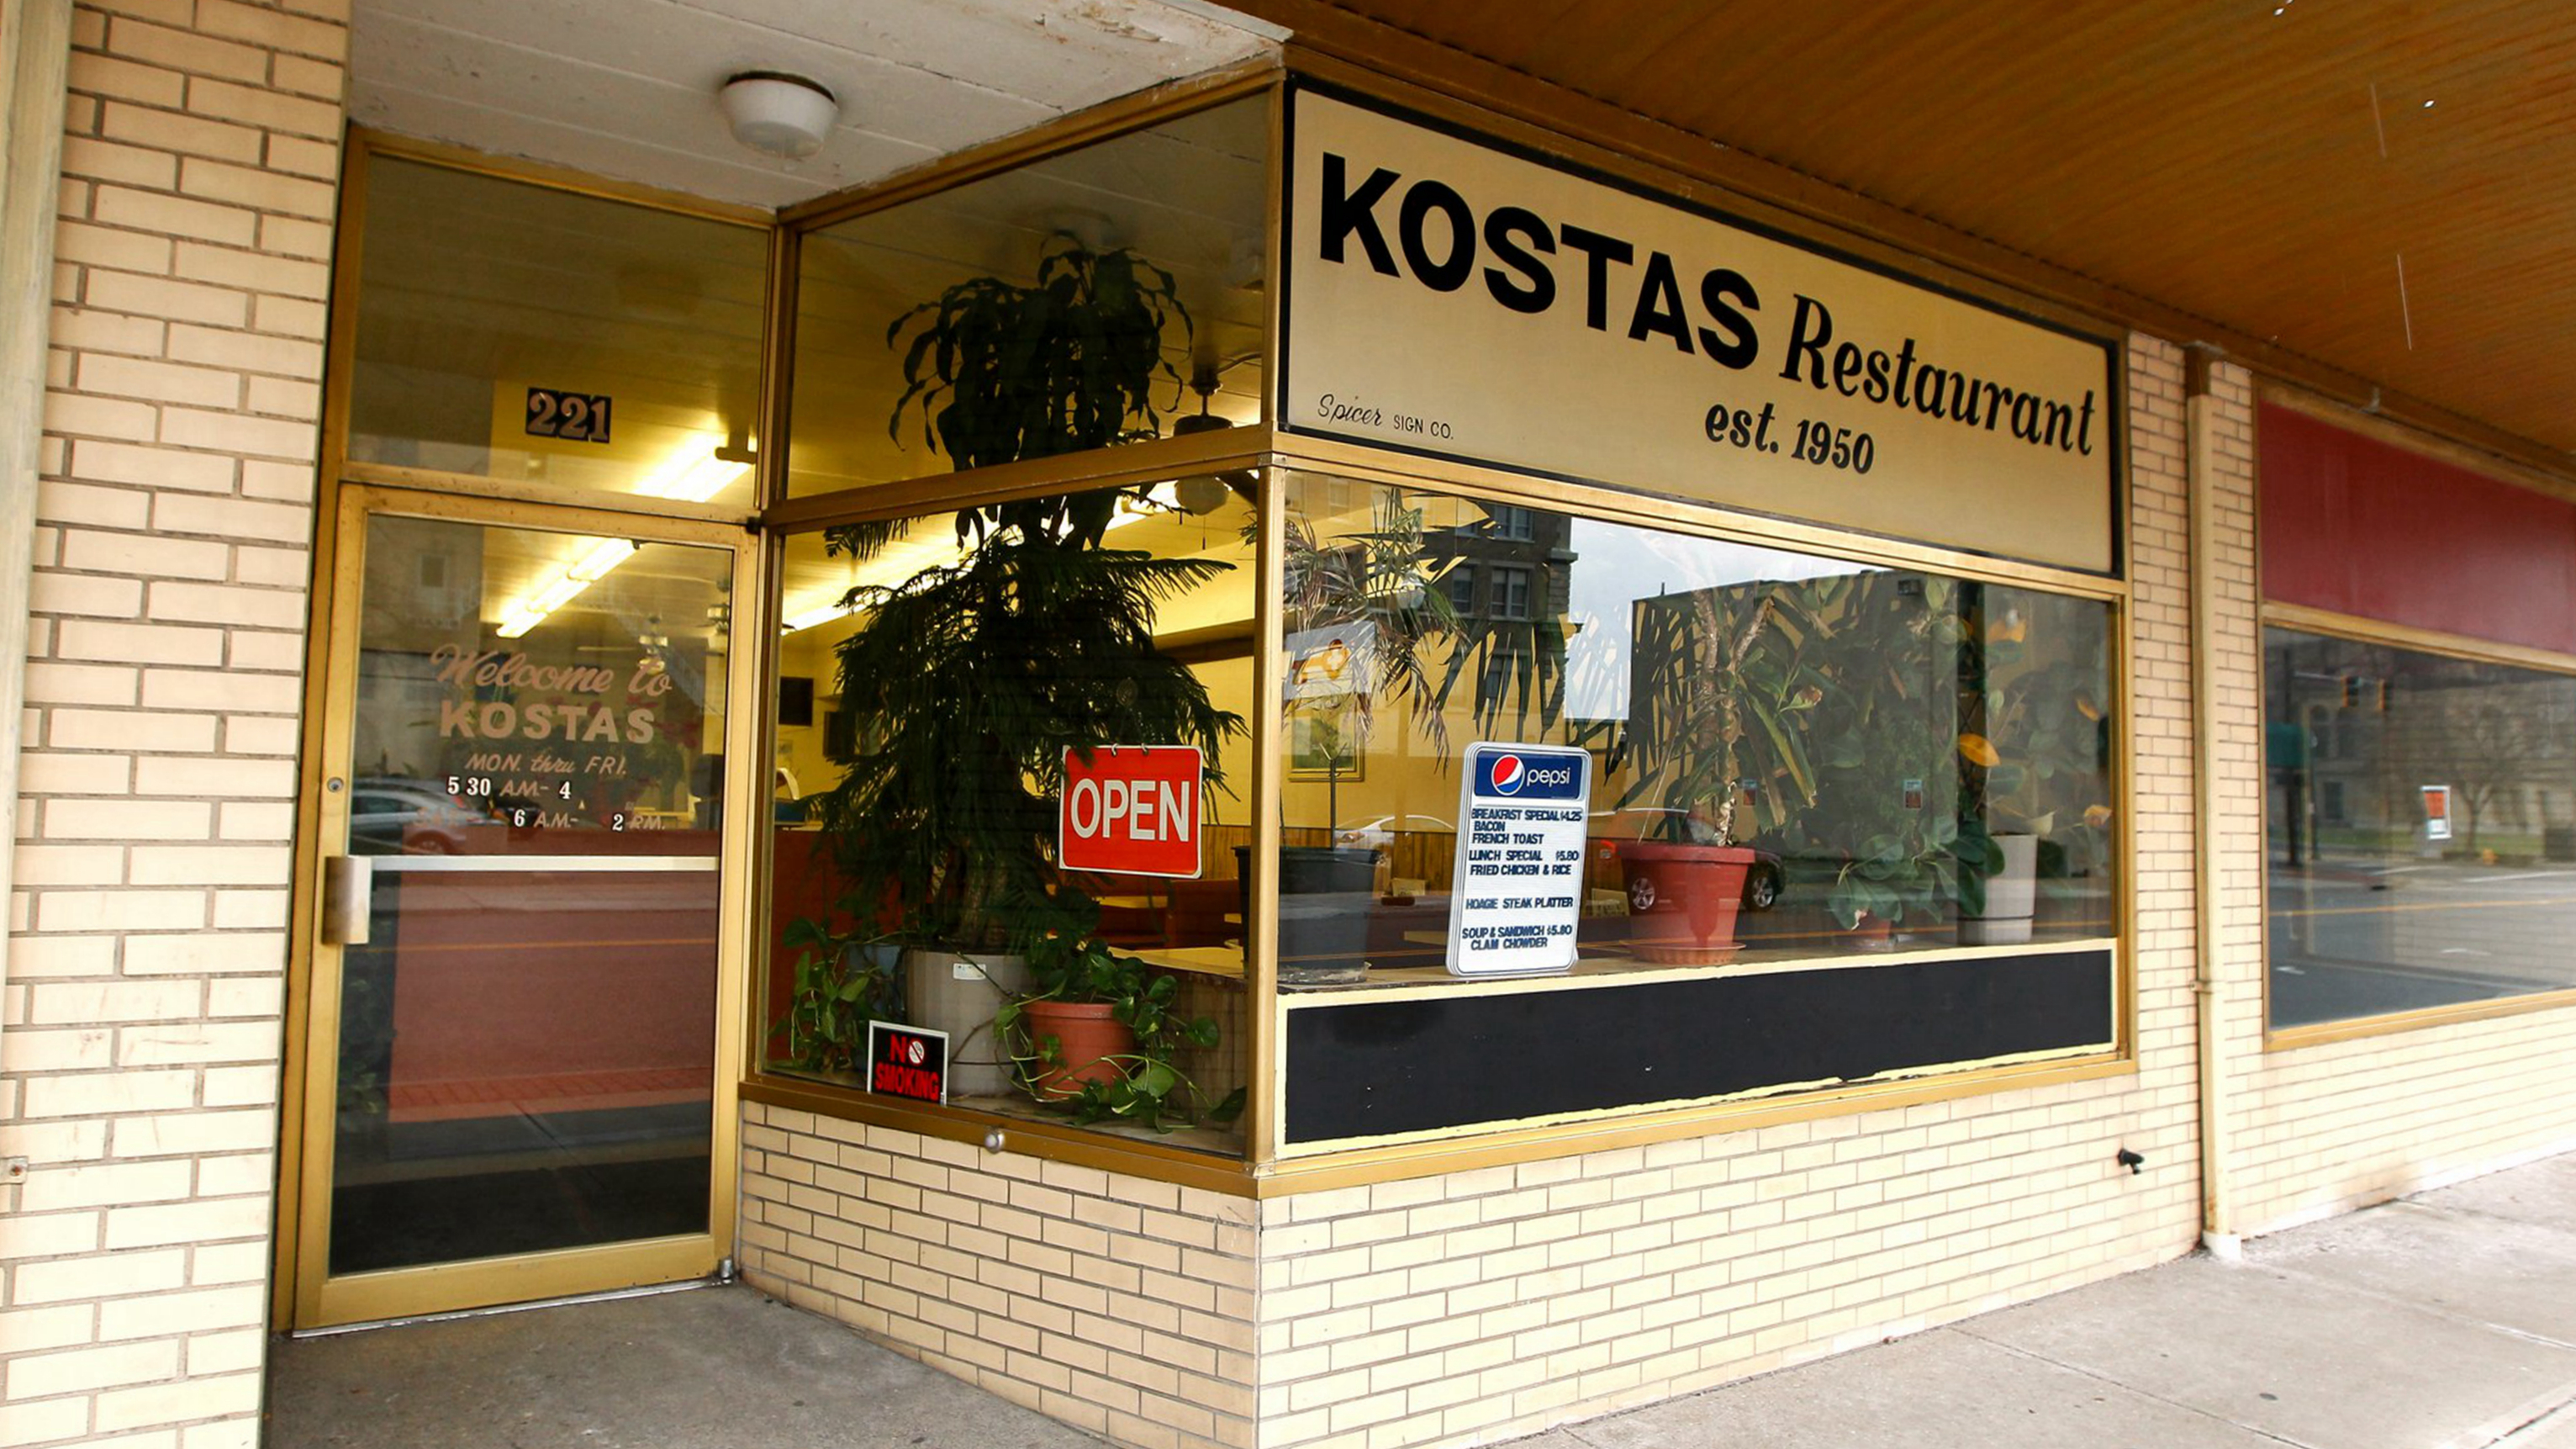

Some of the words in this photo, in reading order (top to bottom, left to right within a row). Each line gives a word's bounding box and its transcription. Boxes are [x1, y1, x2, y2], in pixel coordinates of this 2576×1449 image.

[1320, 151, 1760, 370] KOSTAS
[1779, 293, 2095, 456] Restaurant
[527, 391, 609, 441] 221
[1317, 394, 1382, 426] Spicer
[1393, 415, 1423, 433] SIGN
[1430, 421, 1454, 440] CO.
[1705, 402, 1778, 453] est.
[1791, 420, 1874, 474] 1950
[429, 643, 615, 694] Welcome
[627, 658, 673, 697] to
[439, 700, 655, 744] KOSTAS
[465, 754, 521, 772] MON.
[530, 755, 577, 774] thru
[584, 757, 627, 775] FRI.
[447, 776, 460, 795] 5
[558, 780, 571, 800] 4
[1526, 767, 1570, 788] pepsi
[514, 809, 525, 828] 6
[611, 813, 624, 832] 2
[1070, 778, 1190, 842] OPEN
[1470, 808, 1523, 820] BREAKFAST
[1524, 810, 1560, 821] SPECIAL
[1474, 821, 1506, 832] BACON
[1472, 833, 1510, 844] FRENCH
[1512, 833, 1544, 844] TOAST
[1468, 849, 1502, 861] LUNCH
[1506, 850, 1543, 861] SPECIAL
[1470, 865, 1499, 875] FRIED
[1500, 865, 1539, 875] CHICKEN
[1542, 865, 1549, 875] &
[1551, 865, 1571, 875] RICE
[1465, 897, 1498, 909] HOAGIE
[1502, 897, 1533, 909] STEAK
[1534, 896, 1574, 908] PLATTER
[1461, 928, 1489, 939] SOUP
[1489, 927, 1497, 938] &
[1497, 925, 1545, 938] SANDWICH
[1470, 939, 1499, 950] CLAM
[1502, 937, 1548, 949] CHOWDER
[889, 1034, 925, 1066] NO
[875, 1061, 940, 1101] SMOKING
